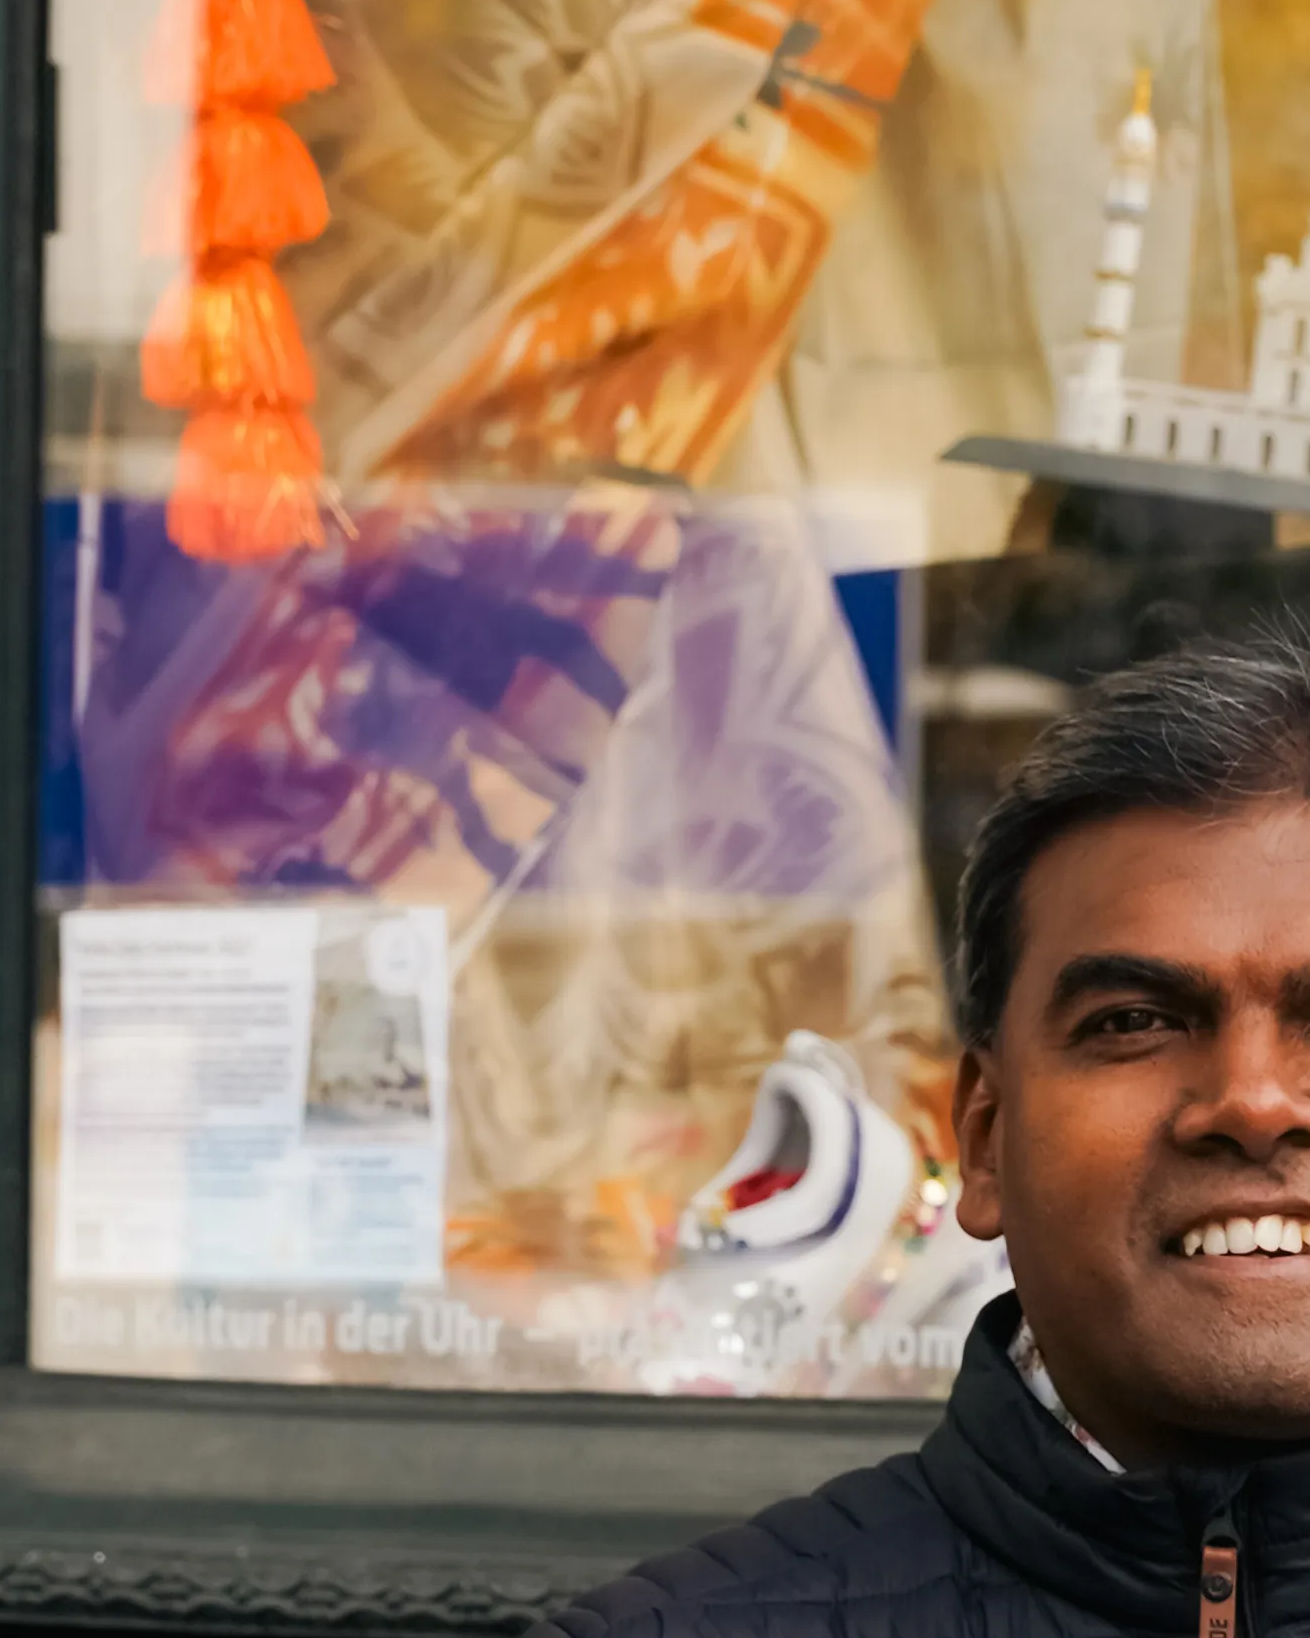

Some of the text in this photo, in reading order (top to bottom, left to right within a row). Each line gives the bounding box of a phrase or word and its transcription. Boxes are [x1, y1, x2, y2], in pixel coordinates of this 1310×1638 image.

[54, 1294, 125, 1347] Die
[134, 1295, 277, 1351] Kultur
[284, 1297, 326, 1351] in
[336, 1298, 412, 1355] der
[419, 1299, 505, 1357] Uhr
[859, 1323, 965, 1369] vom
